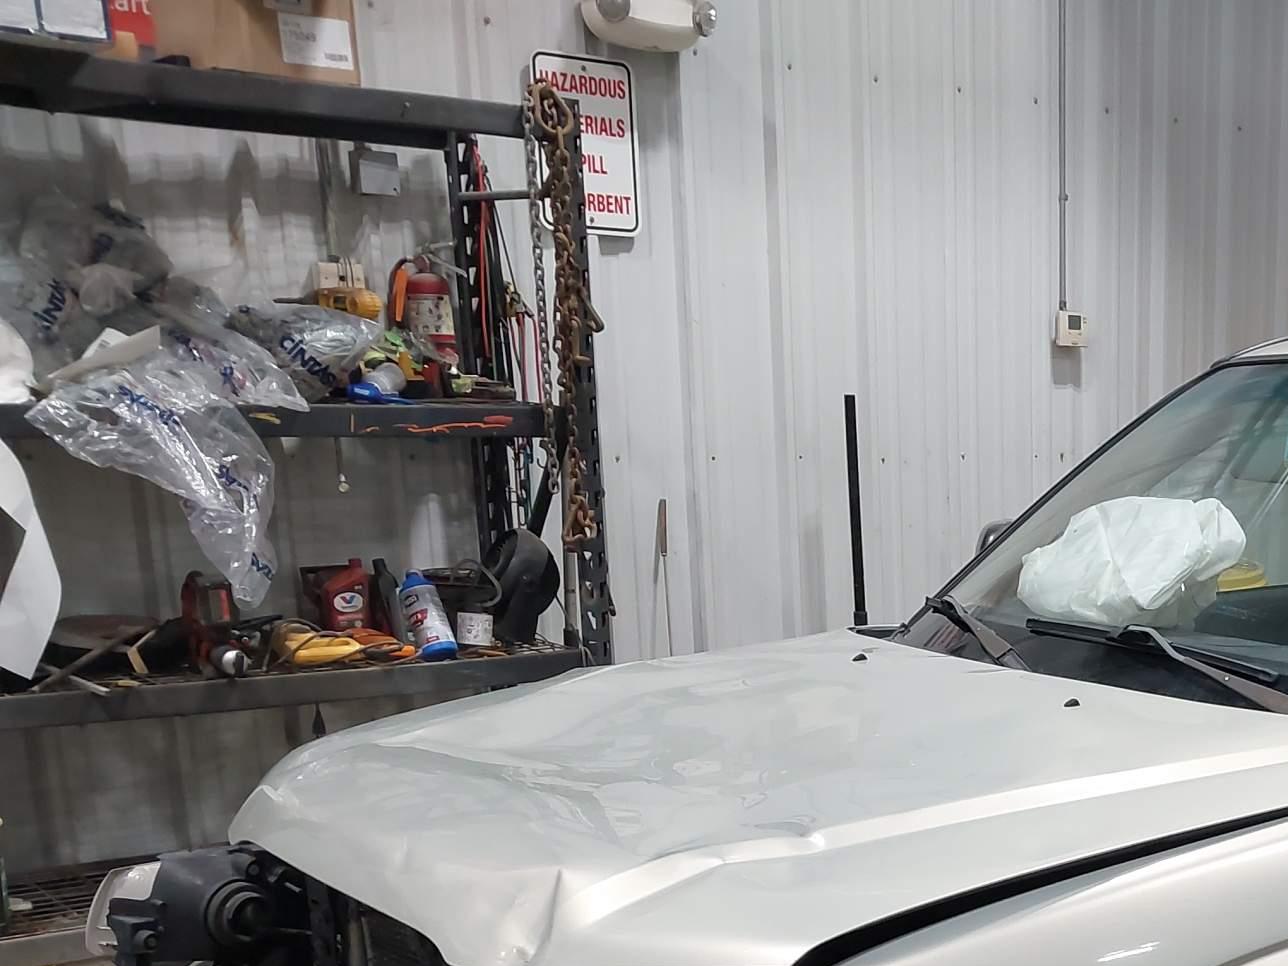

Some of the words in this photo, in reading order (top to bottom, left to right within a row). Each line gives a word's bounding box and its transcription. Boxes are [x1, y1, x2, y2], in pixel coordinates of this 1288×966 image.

[110, 0, 152, 15] art
[539, 69, 626, 99] HAZARDOUS
[580, 114, 625, 138] ERIALS
[581, 153, 608, 175] PILL
[585, 193, 631, 215] RBENT
